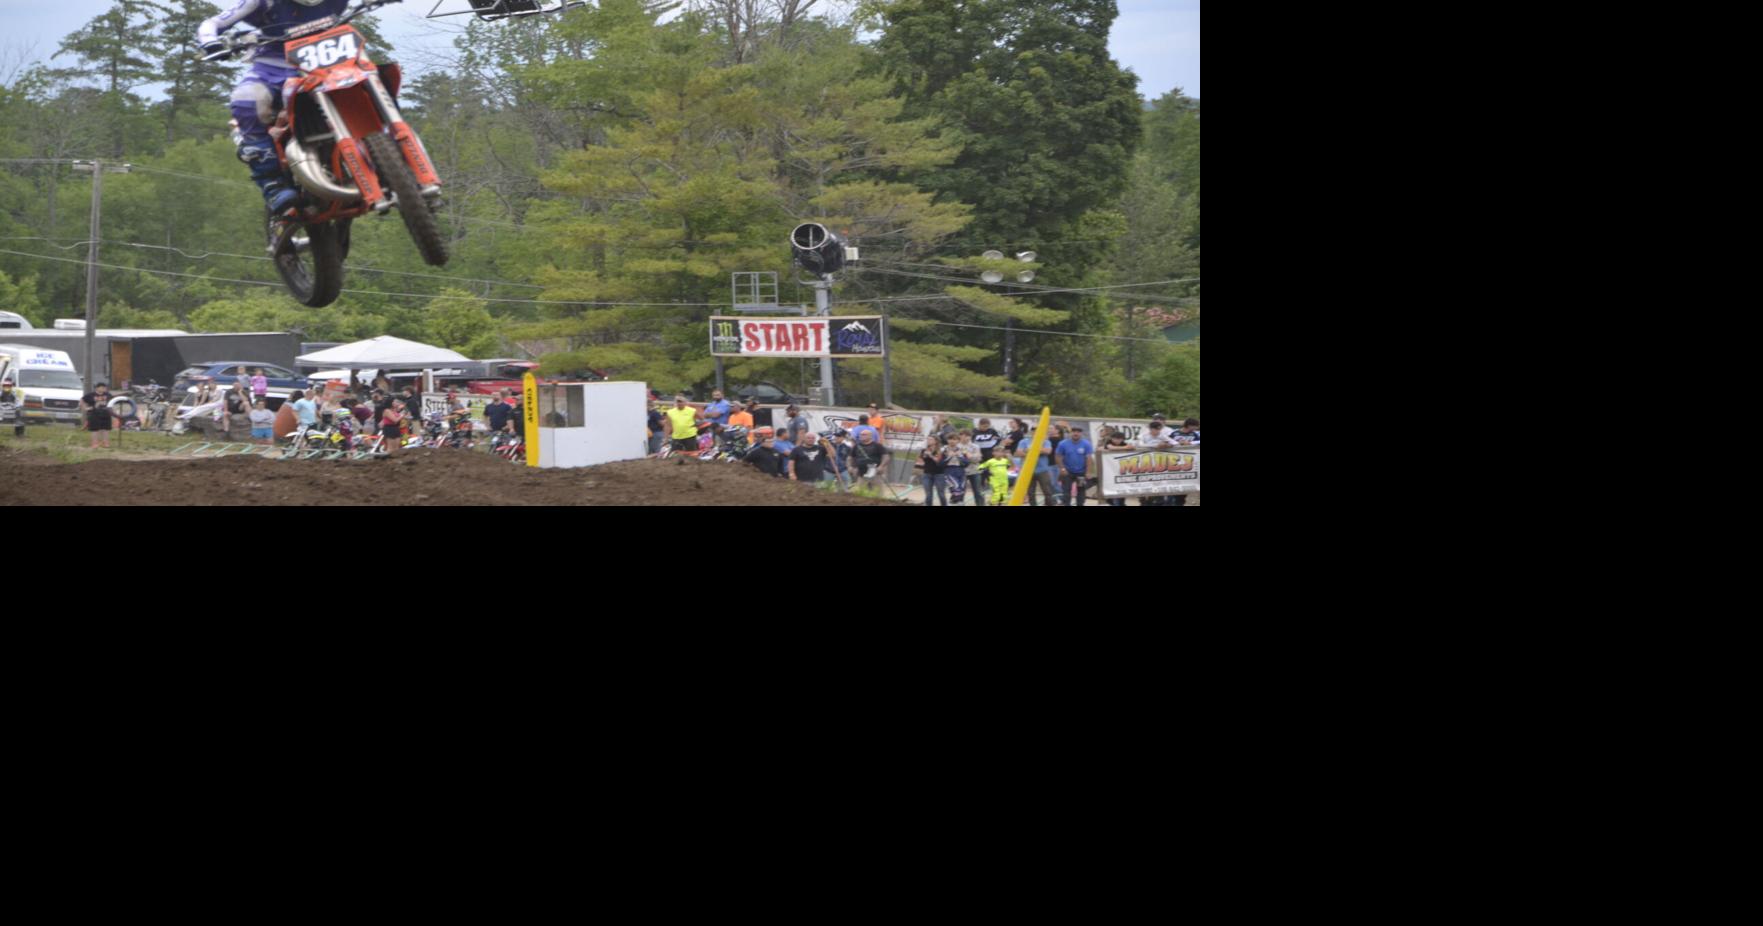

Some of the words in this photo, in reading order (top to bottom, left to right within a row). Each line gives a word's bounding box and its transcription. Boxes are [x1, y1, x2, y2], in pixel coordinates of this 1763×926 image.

[296, 33, 358, 72] 364
[743, 322, 826, 352] START
[1119, 453, 1195, 476] MADEJ
